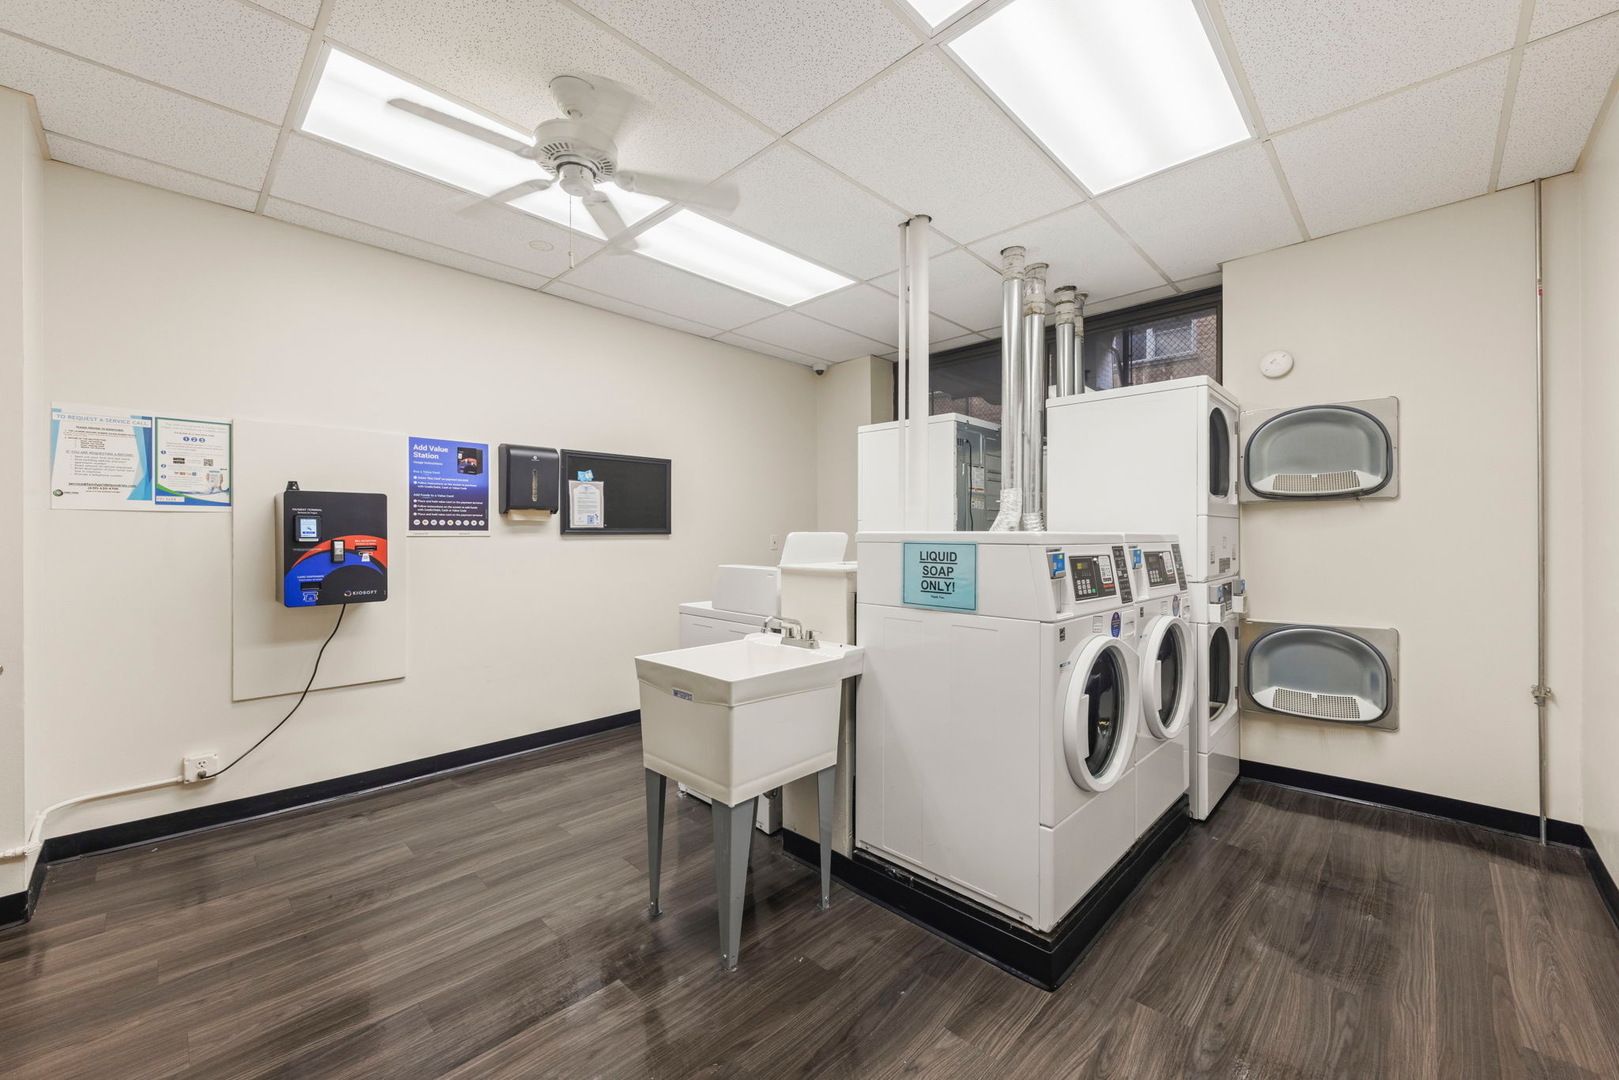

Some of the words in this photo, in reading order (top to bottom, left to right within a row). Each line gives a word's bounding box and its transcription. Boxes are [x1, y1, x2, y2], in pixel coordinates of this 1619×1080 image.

[920, 551, 957, 562] LIQUID
[922, 565, 954, 576] SOAP
[921, 580, 955, 592] ONLY!
